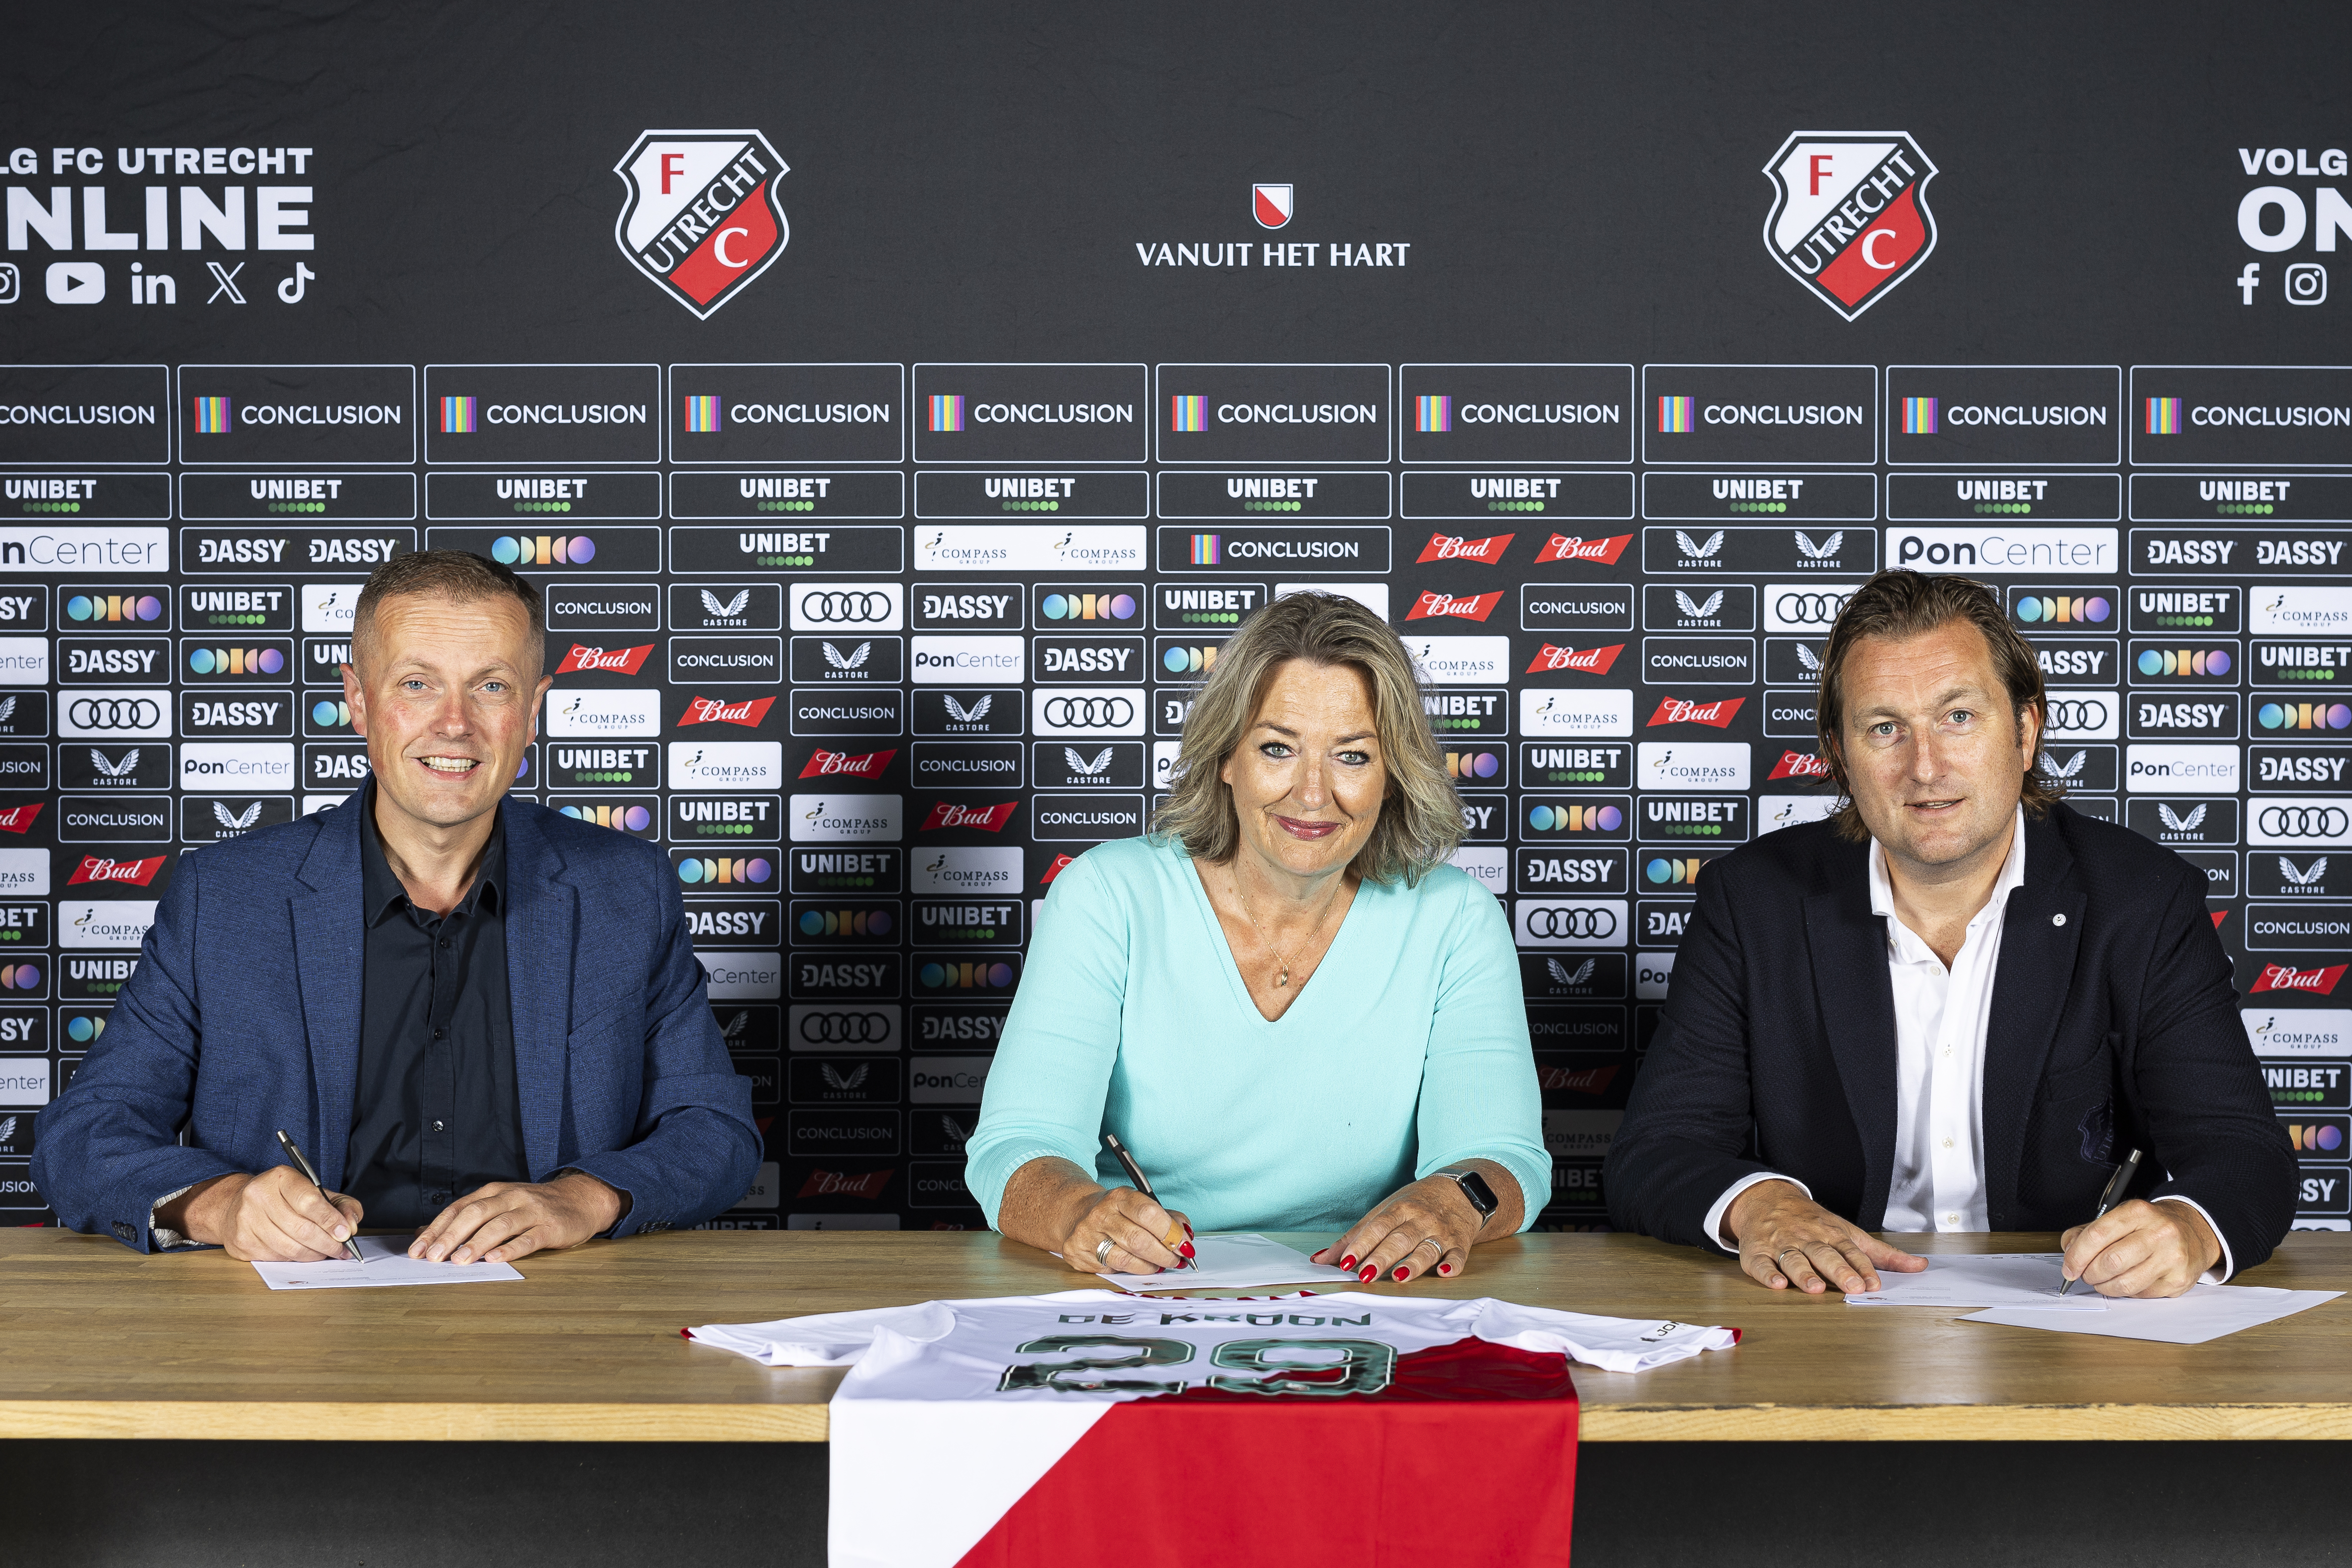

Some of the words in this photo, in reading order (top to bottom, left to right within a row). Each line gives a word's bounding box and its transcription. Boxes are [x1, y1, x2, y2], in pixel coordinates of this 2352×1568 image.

[53, 147, 103, 175] FC
[118, 147, 313, 175] UTRECHT
[2238, 148, 2348, 176] VOLG
[661, 153, 684, 195] F
[1810, 155, 1833, 196] F
[642, 147, 767, 273] UTRECHT
[1790, 149, 1916, 274] UTRECHT
[714, 227, 748, 268] C
[1135, 242, 1253, 267] VANUIT
[1263, 243, 1320, 267] HET
[1330, 243, 1410, 267] HART
[1861, 228, 1897, 269] C
[241, 405, 401, 424] CONCLUSION
[487, 405, 646, 424] CONCLUSION
[731, 404, 889, 423] CONCLUSION
[974, 404, 1132, 423] CONCLUSION
[1218, 404, 1376, 423] CONCLUSION
[1461, 404, 1619, 423] CONCLUSION
[1704, 405, 1862, 424] CONCLUSION
[1948, 406, 2106, 425] CONCLUSION
[5, 480, 97, 499] UNIBET
[251, 480, 342, 499] UNIBET
[497, 479, 587, 499] UNIBET
[741, 478, 831, 498] UNIBET
[985, 478, 1075, 498] UNIBET
[1227, 478, 1318, 498] UNIBET
[1471, 478, 1561, 498] UNIBET
[1713, 479, 1803, 499] UNIBET
[1957, 480, 2048, 500] UNIBET
[2200, 481, 2290, 501] UNIBET
[199, 539, 286, 563] DASSY
[309, 539, 396, 563] DASSY
[740, 533, 830, 553] UNIBET
[1228, 541, 1358, 558] CONCLUSION
[1433, 536, 1491, 558] Bud
[1551, 536, 1609, 558] Bud
[1895, 535, 2106, 571] PonCenter
[2147, 540, 2234, 564] DASSY
[2256, 541, 2343, 565] DASSY
[942, 549, 1006, 558] COMPASS
[1071, 549, 1136, 558] COMPASS
[191, 592, 282, 611] UNIBET
[555, 602, 651, 614] CONCLUSION
[923, 595, 1009, 619] DASSY
[1165, 590, 1256, 610] UNIBET
[1422, 594, 1480, 616] Bud
[1529, 602, 1625, 614] CONCLUSION
[2140, 593, 2230, 613] UNIBET
[2282, 612, 2348, 621] COMPASS
[69, 649, 156, 673] DASSY
[572, 647, 631, 669] Bud
[677, 654, 773, 667] CONCLUSION
[915, 652, 1017, 667] PonCenter
[1044, 648, 1130, 671] DASSY
[1429, 661, 1494, 670] COMPASS
[1543, 646, 1601, 668] Bud
[1651, 655, 1747, 667] CONCLUSION
[2038, 650, 2104, 674] ASSY
[2261, 646, 2352, 666] UNIBET
[192, 702, 279, 726] DASSY
[694, 700, 752, 721] Bud
[799, 707, 894, 719] CONCLUSION
[1424, 696, 1497, 715] NIBET
[1664, 700, 1722, 722] Bud
[580, 715, 645, 723] COMPASS
[1553, 714, 1617, 723] COMPASS
[2139, 704, 2225, 728] DASSY
[184, 759, 287, 774] PonCenter
[315, 754, 370, 778] DAS
[558, 749, 648, 769] UNIBET
[816, 752, 873, 773] Bud
[920, 760, 1015, 772] CONCLUSION
[1531, 749, 1621, 768] UNIBET
[2131, 761, 2233, 776] PonCenter
[701, 766, 766, 776] COMPASS
[1670, 767, 1735, 777] COMPASS
[2259, 757, 2346, 781] DASSY
[67, 814, 163, 826] CONCLUSION
[680, 802, 770, 821] UNIBET
[937, 805, 994, 826] Bud
[1041, 812, 1136, 824] CONCLUSION
[1648, 802, 1738, 822] UNIBET
[823, 818, 890, 830] COMPASS
[85, 858, 142, 880] Bud
[801, 854, 891, 873] UNIBET
[1528, 859, 1613, 882] DASSY
[943, 870, 1008, 881] COMPASS
[922, 907, 1012, 926] UNIBET
[92, 925, 149, 935] COMPAS
[2254, 922, 2350, 934] CONCLUSION
[70, 960, 137, 979] UNIB
[801, 964, 886, 987] DASSY
[2267, 967, 2325, 988] Bud
[2273, 1034, 2338, 1043] COMPASS
[797, 1128, 892, 1139] CONCLUSION
[1546, 1134, 1611, 1144] COMPASS
[814, 1172, 870, 1193] Bud
[1058, 1313, 1135, 1325] DE
[995, 1334, 1397, 1396] 29
